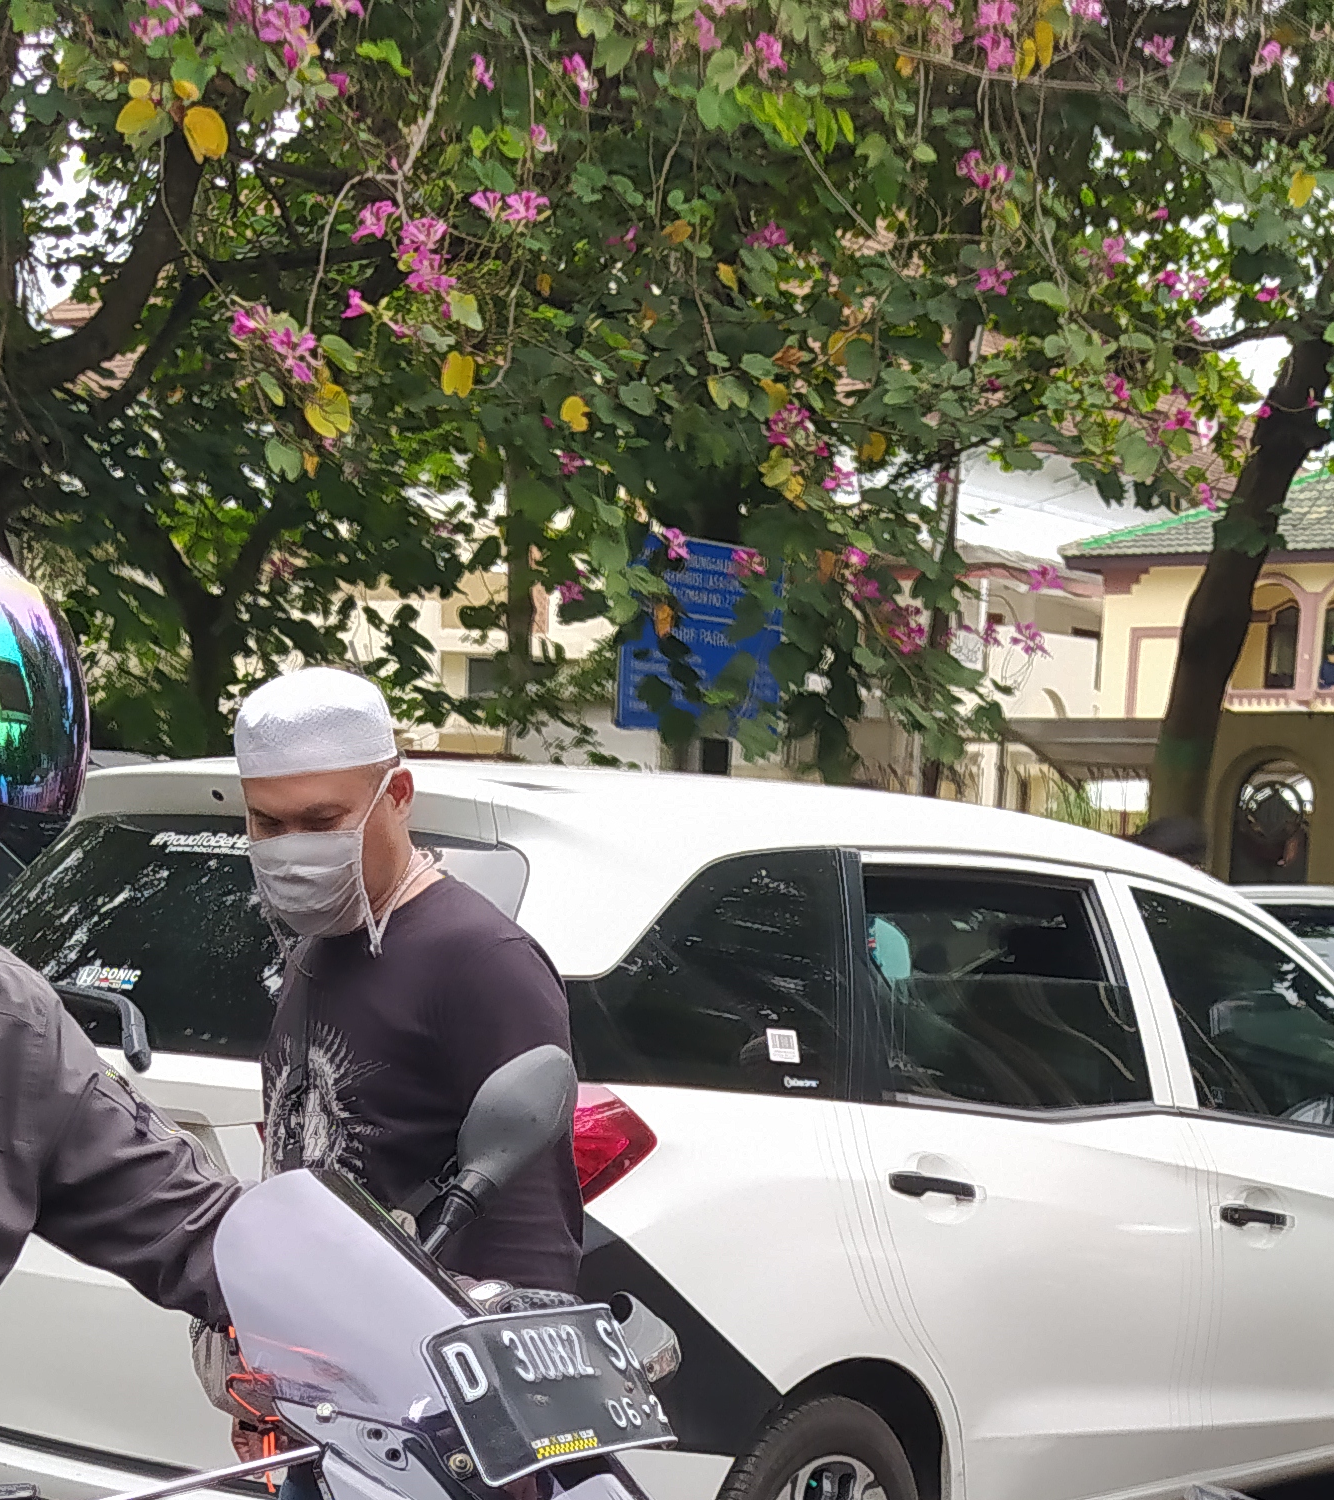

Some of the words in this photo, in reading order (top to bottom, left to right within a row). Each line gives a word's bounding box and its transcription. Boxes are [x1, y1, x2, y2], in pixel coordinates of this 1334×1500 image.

[100, 966, 142, 982] SONIC
[441, 1342, 489, 1403] D
[501, 1325, 599, 1382] 3082
